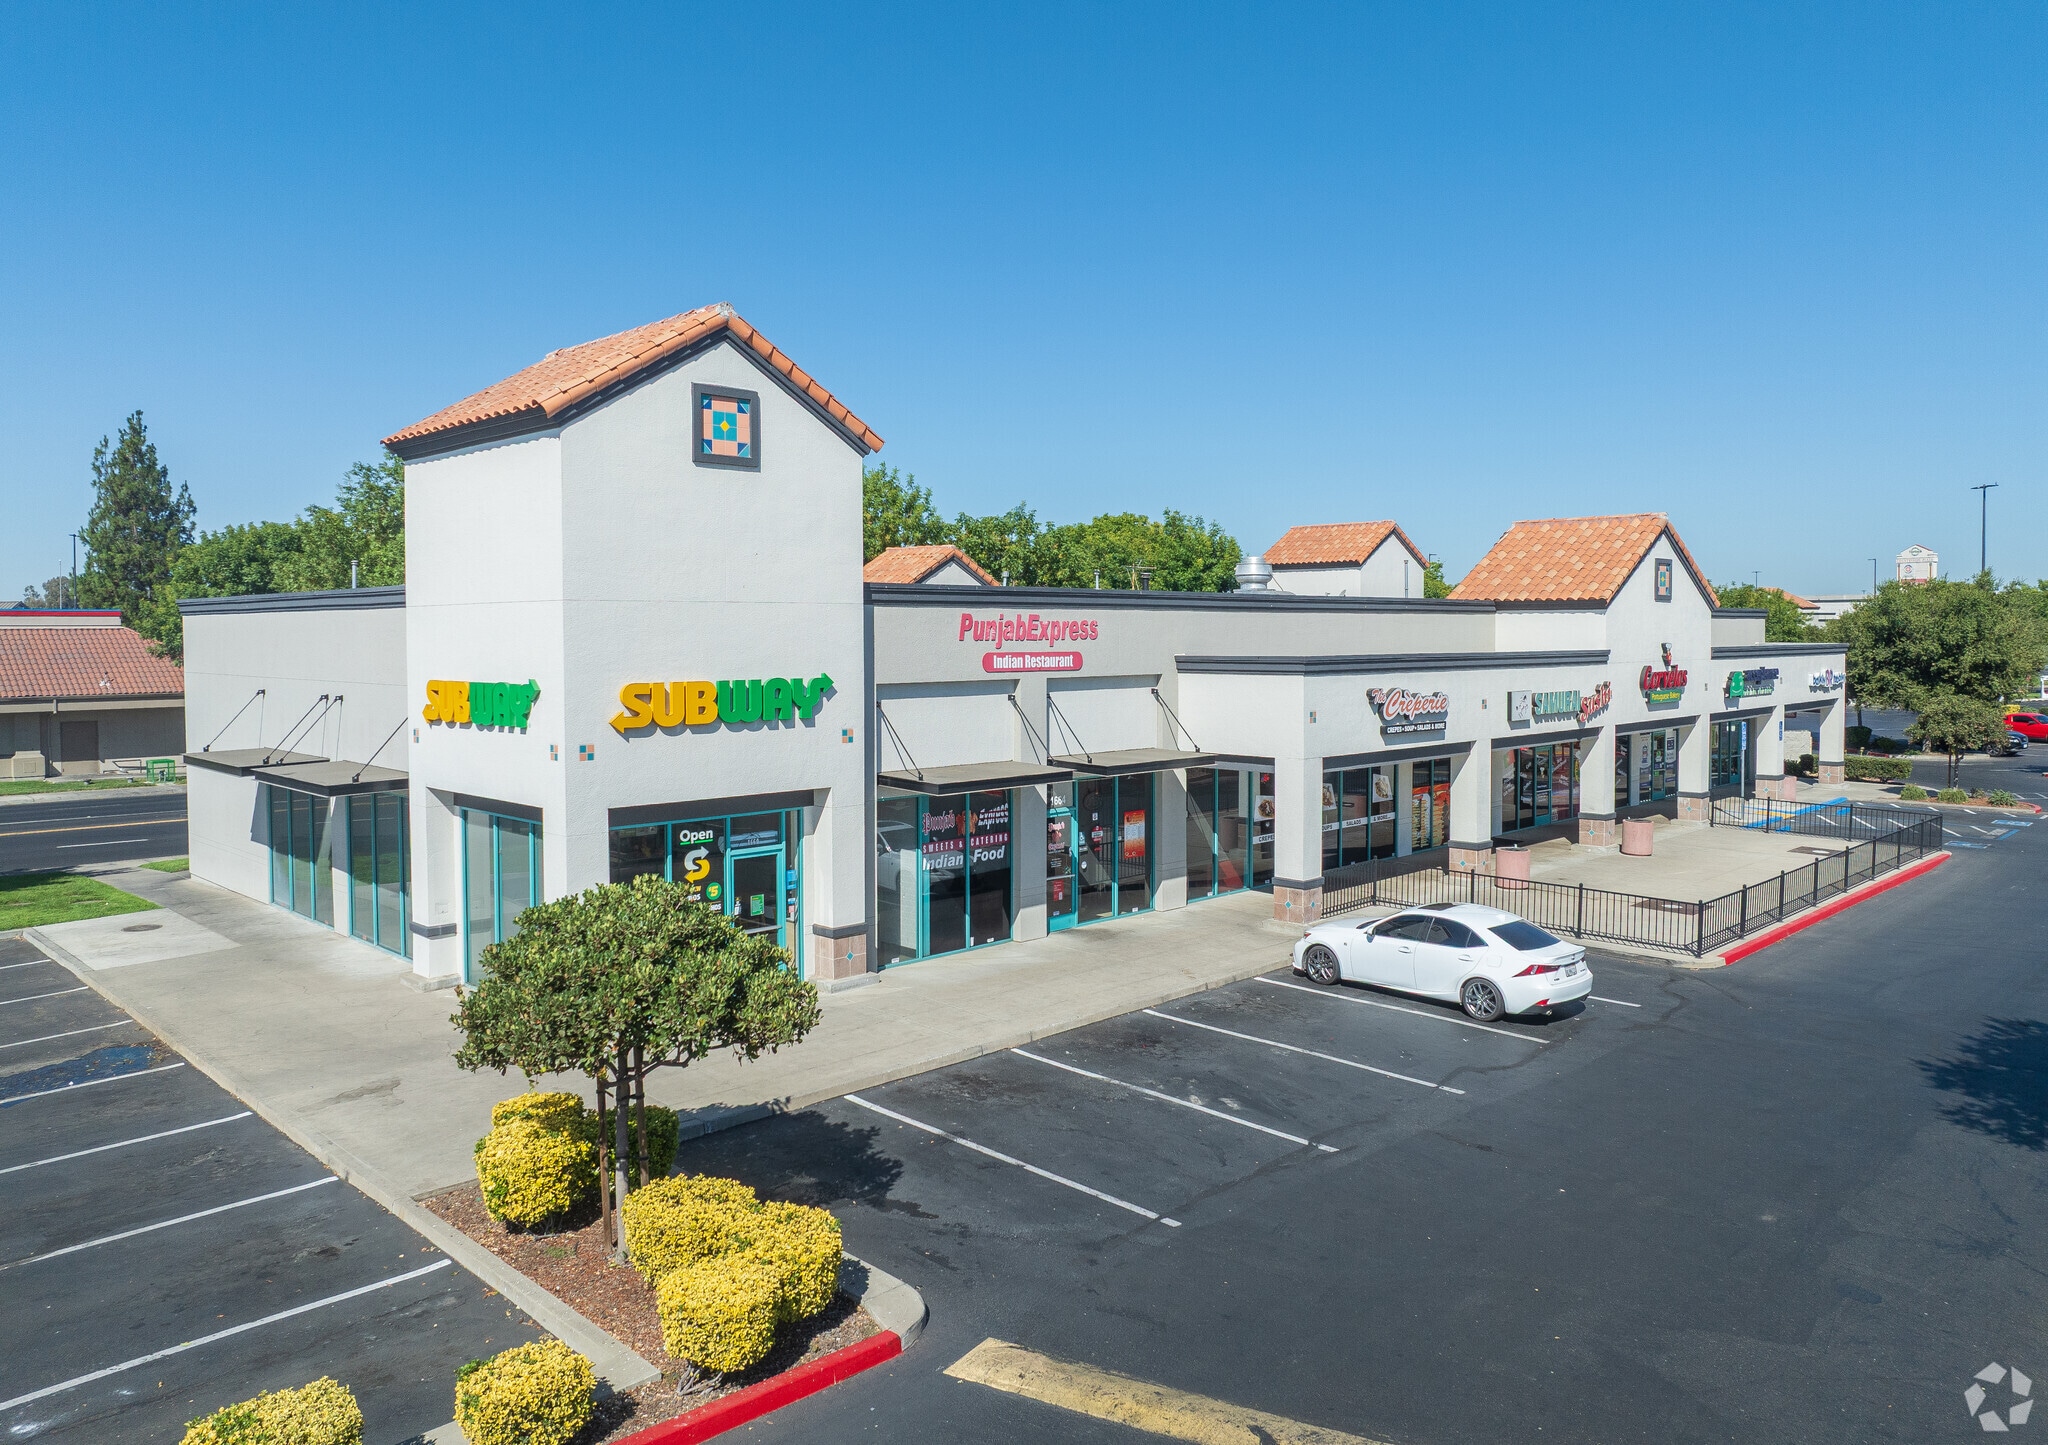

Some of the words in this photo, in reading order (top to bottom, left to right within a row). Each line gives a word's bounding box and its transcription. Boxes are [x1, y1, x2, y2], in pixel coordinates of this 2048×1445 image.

[959, 613, 1099, 649] PunjabExpress
[993, 655, 1023, 669] Indian
[1025, 654, 1074, 668] Restaurant
[422, 679, 541, 728] SUBWAY
[609, 673, 834, 733] SUBWAY
[1372, 689, 1386, 704] The
[1535, 690, 1580, 715] SAMURAI
[1580, 681, 1611, 722] Sushi
[680, 830, 714, 844] Open
[922, 840, 954, 854] SWEETS
[959, 840, 963, 849] &
[970, 833, 1009, 846] CATERING
[922, 853, 964, 871] Indian
[973, 845, 1006, 863] Food
